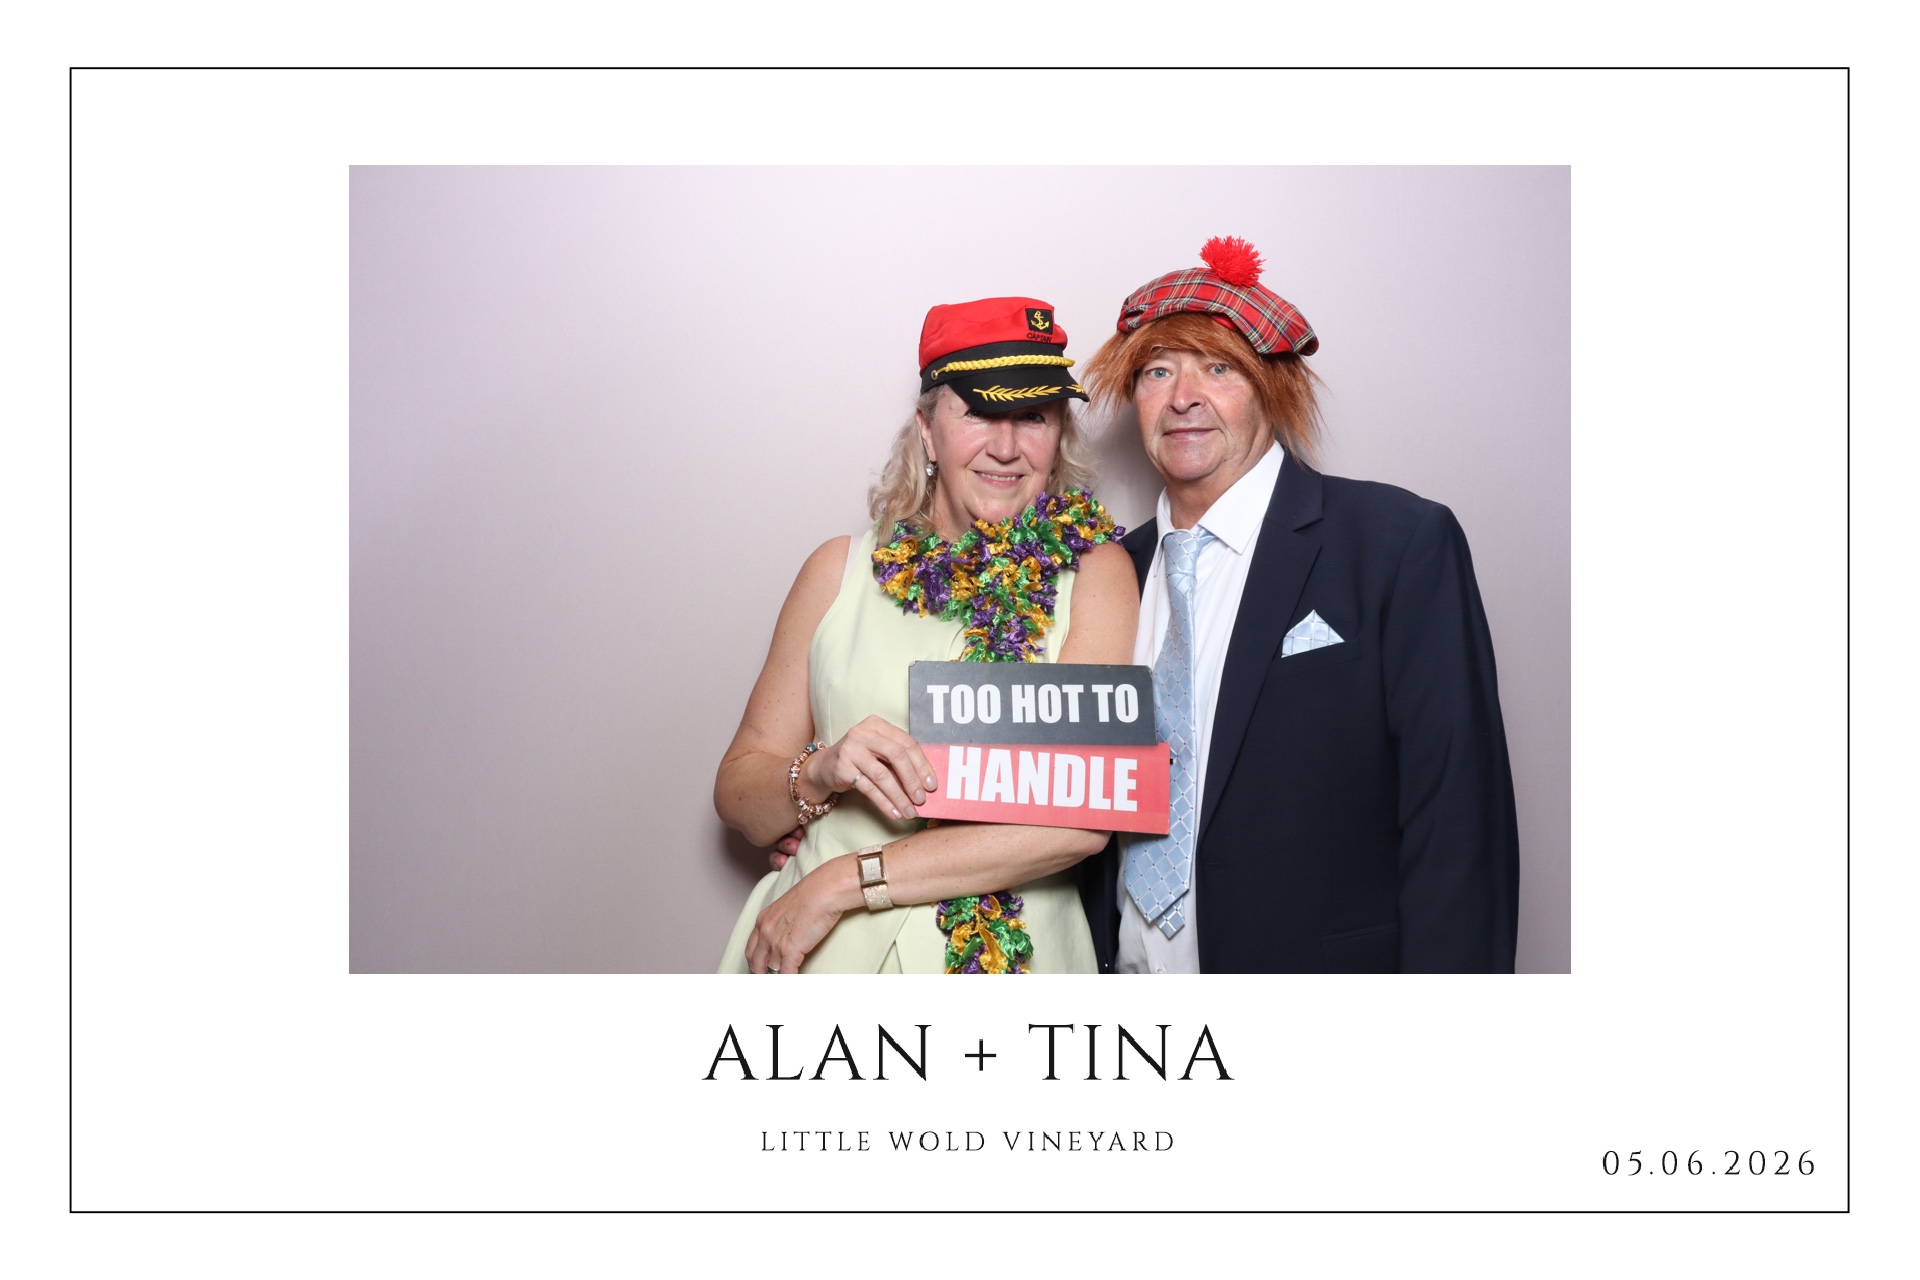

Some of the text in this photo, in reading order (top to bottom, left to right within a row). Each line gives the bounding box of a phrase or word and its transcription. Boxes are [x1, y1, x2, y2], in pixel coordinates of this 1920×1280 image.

[1026, 332, 1053, 343] CAPTAIN
[926, 683, 1139, 724] TOO HOT TO
[946, 745, 1138, 812] HANDLE
